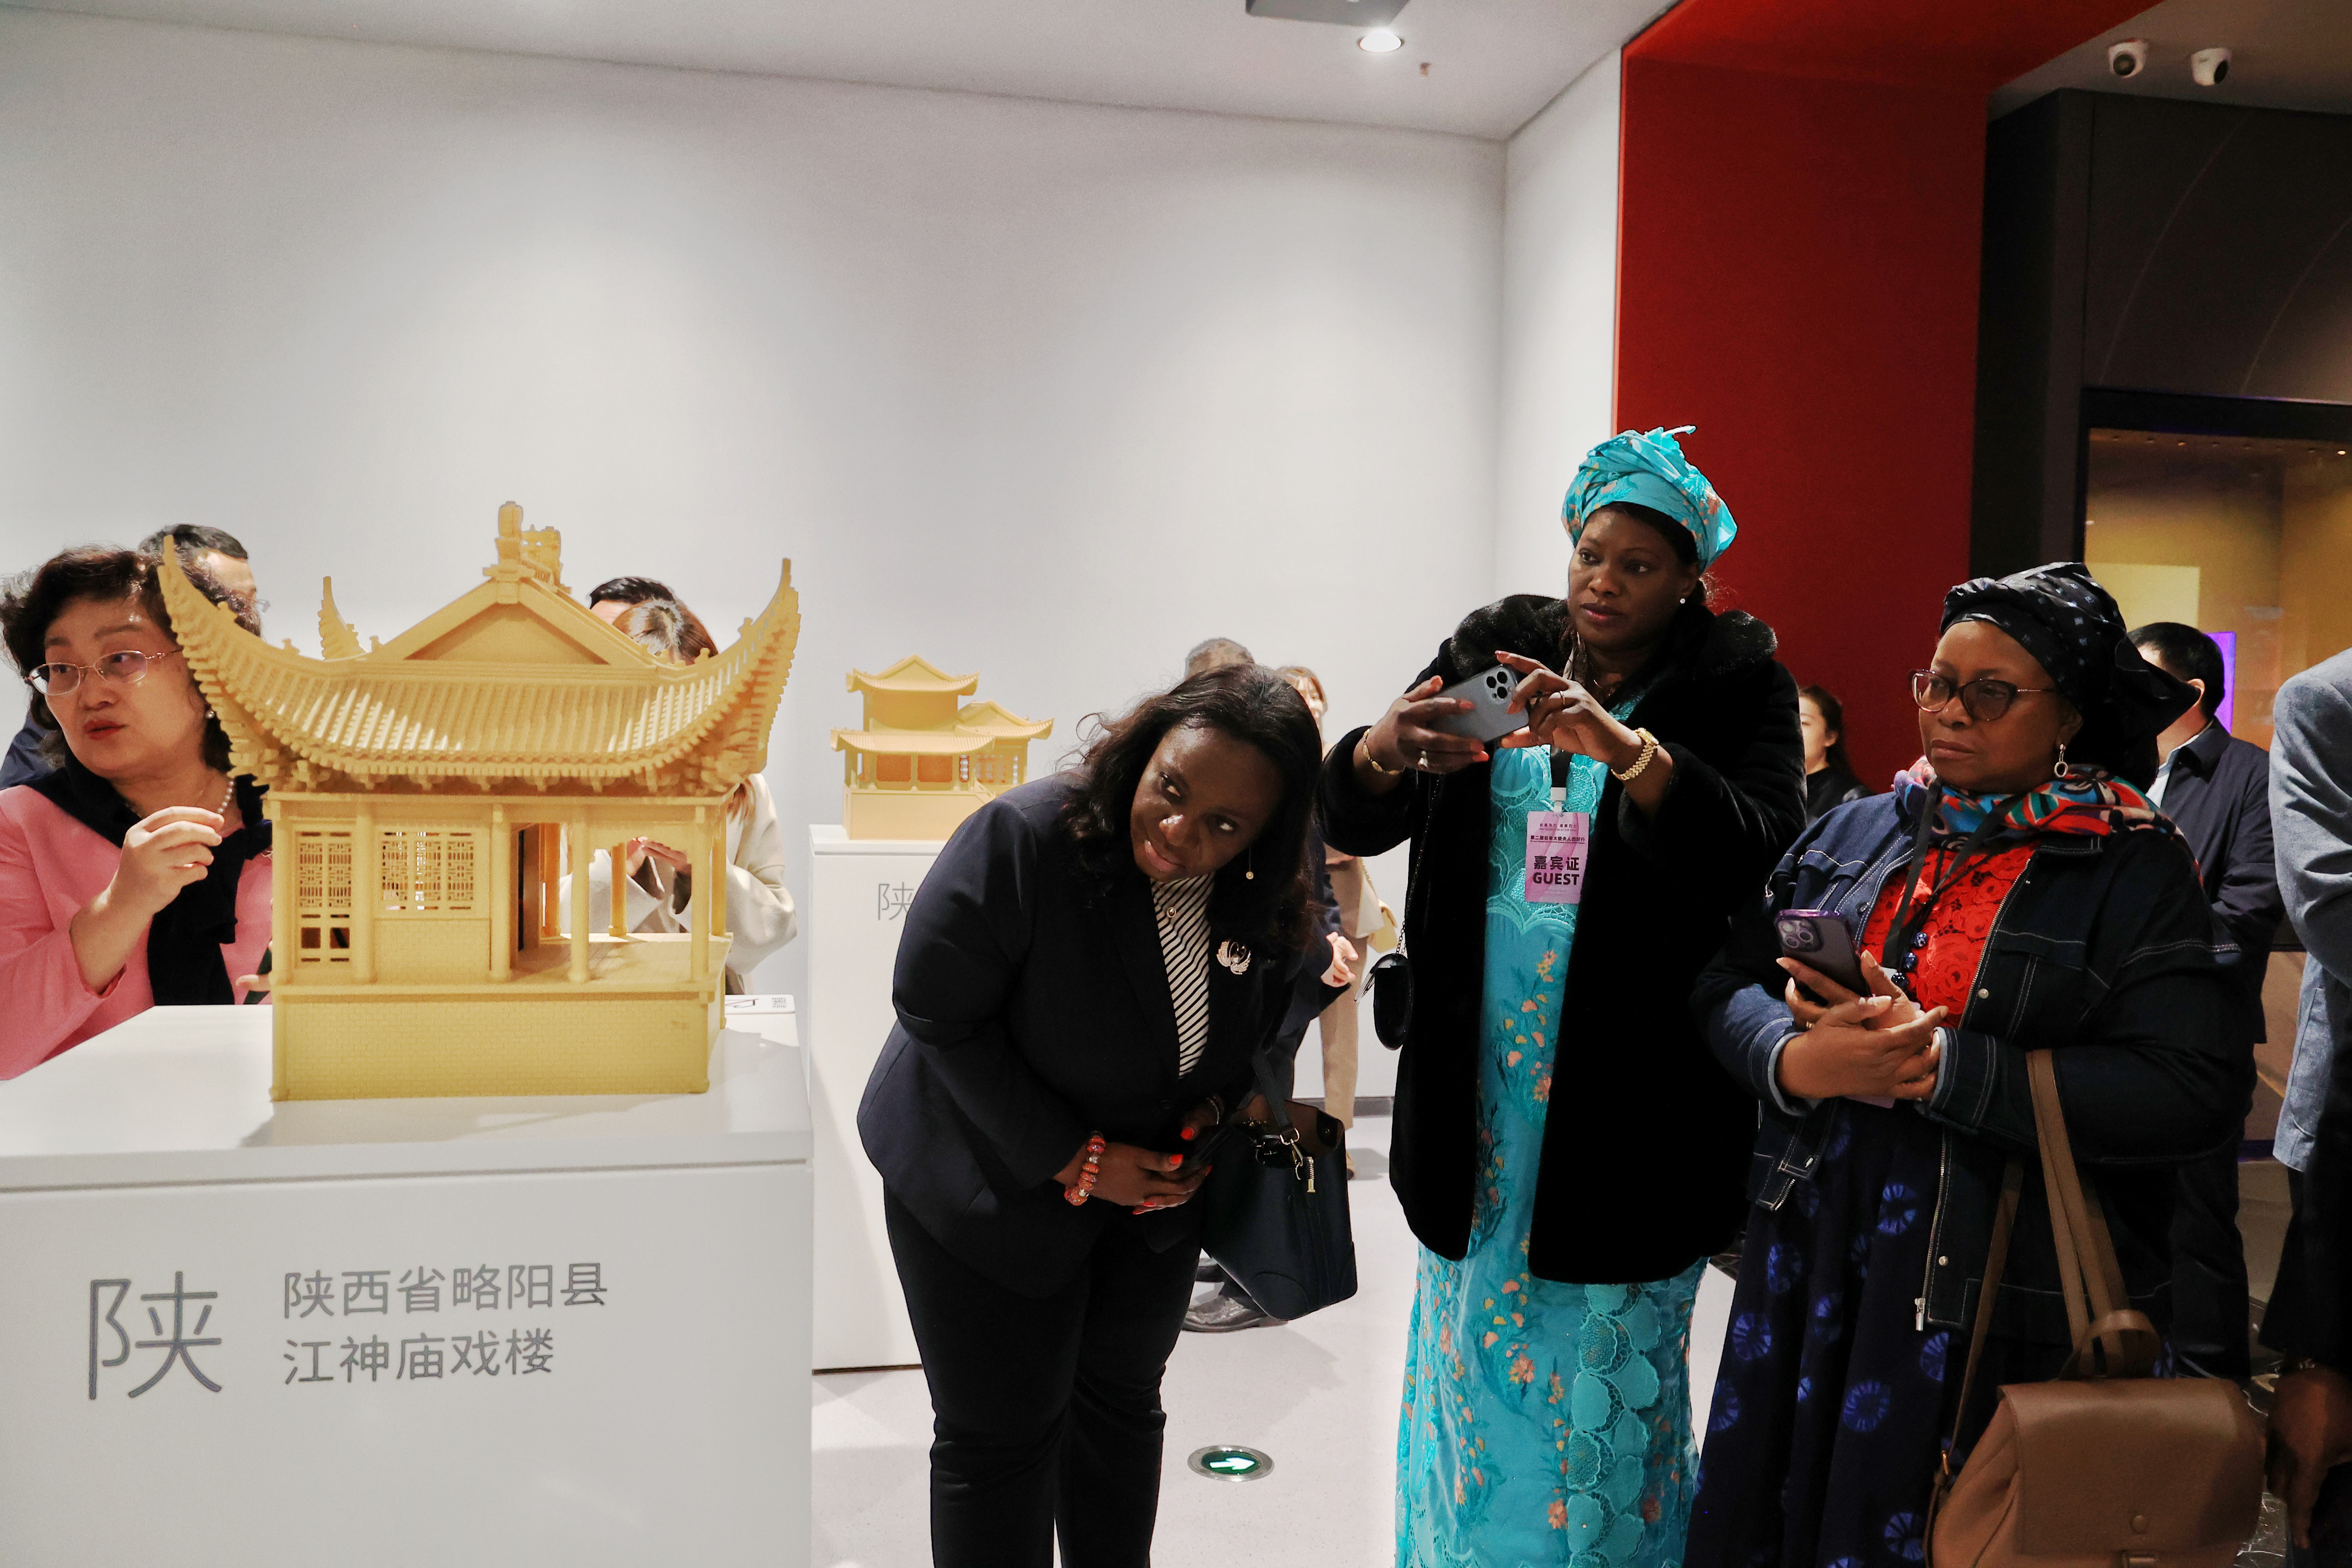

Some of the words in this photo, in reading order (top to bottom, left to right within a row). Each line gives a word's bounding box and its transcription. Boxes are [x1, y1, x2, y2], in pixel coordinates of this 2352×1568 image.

[1533, 872, 1580, 885] GUEST
[1534, 855, 1580, 871] 嘉宾证
[878, 882, 914, 920] 陕
[284, 1262, 607, 1319] 陕西省略阳县
[89, 1271, 223, 1401] 陕
[284, 1328, 553, 1385] 江神庙戏楼
